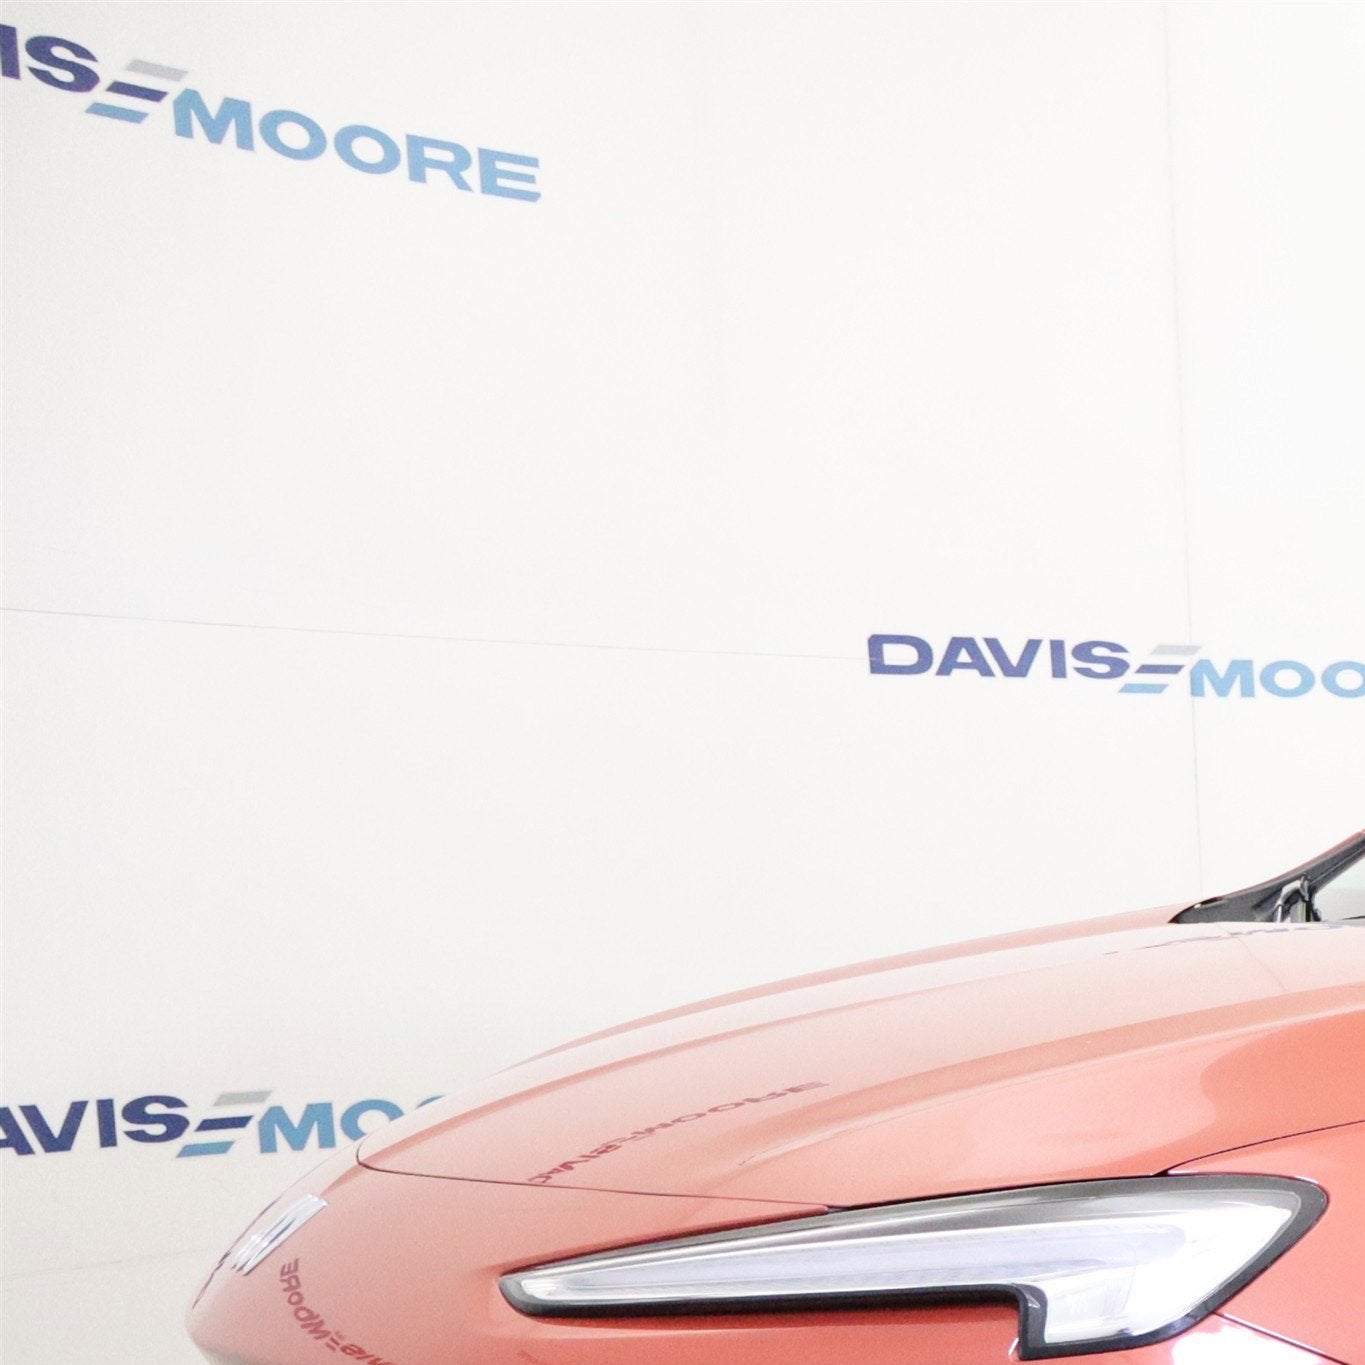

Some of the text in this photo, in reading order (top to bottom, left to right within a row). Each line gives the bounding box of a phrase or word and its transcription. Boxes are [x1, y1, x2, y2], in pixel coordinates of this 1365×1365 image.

[174, 88, 541, 203] MOORE
[868, 634, 1131, 680] DAVIS
[258, 1094, 446, 1154] MO
